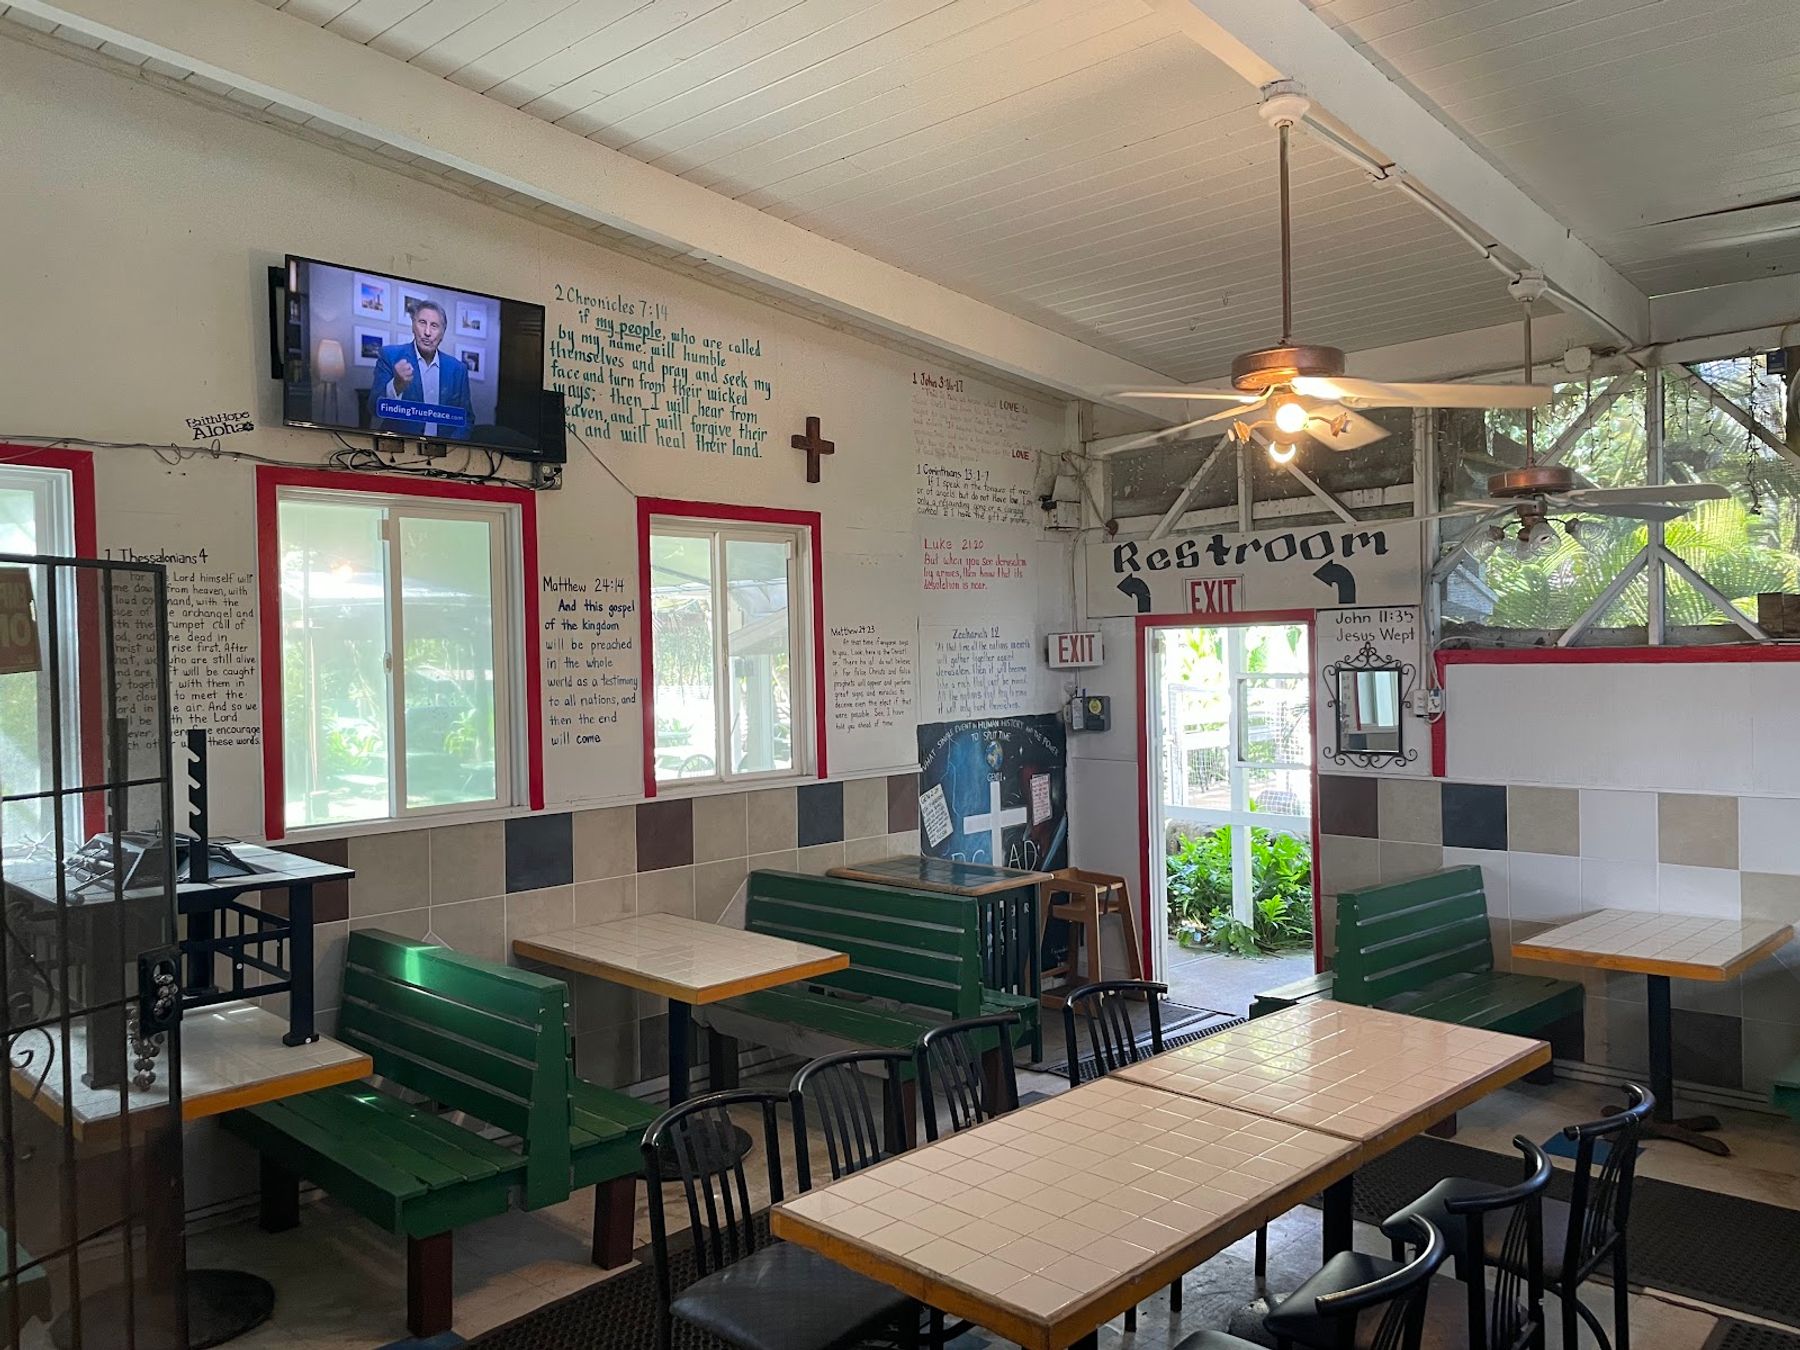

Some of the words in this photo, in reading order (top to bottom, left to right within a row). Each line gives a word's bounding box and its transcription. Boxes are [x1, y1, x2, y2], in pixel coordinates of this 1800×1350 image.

[555, 284, 564, 301] 2
[567, 287, 635, 315] Chronicles
[638, 300, 667, 321] 7:14
[579, 308, 590, 324] if
[595, 317, 614, 338] my
[671, 328, 696, 345] who
[702, 338, 723, 350] are
[729, 338, 761, 357] called
[559, 324, 575, 353] by
[581, 334, 600, 356] my
[651, 343, 675, 359] will
[683, 344, 727, 367] humble
[549, 340, 625, 368] themselves
[632, 356, 655, 373] and
[662, 365, 688, 387] pray
[695, 366, 718, 384] and
[722, 371, 748, 389] seek
[754, 379, 771, 401] my
[550, 359, 580, 379] face
[583, 366, 606, 384] and
[609, 368, 634, 389] turn
[639, 372, 665, 392] from
[673, 378, 703, 398] their
[706, 387, 748, 406] wicked
[380, 403, 464, 421] FindingTruePeace.com
[609, 388, 642, 408] then
[650, 392, 660, 411] I
[666, 397, 690, 415] will
[698, 400, 725, 419] hear
[730, 404, 758, 424] from
[1000, 400, 1019, 413] LOVE
[564, 406, 607, 424] eaven,
[610, 408, 634, 424] and
[641, 408, 651, 427] I
[656, 412, 683, 431] will
[690, 415, 732, 443] forgive
[739, 423, 768, 443] their
[585, 422, 611, 440] and
[620, 426, 647, 444] will
[656, 428, 686, 450] heal
[696, 434, 727, 454] their
[732, 439, 763, 458] land.
[923, 463, 962, 478] Corinthians
[924, 538, 953, 550] Luke
[118, 547, 198, 565] Thessalonians
[199, 547, 208, 564] 4
[924, 552, 938, 565] But
[1113, 530, 1389, 574] Restroom
[173, 570, 195, 582] Lord
[200, 572, 235, 583] himself
[192, 584, 227, 597] heaven,
[228, 586, 248, 596] with
[543, 576, 586, 592] Matthew
[594, 579, 625, 593] 24:14
[196, 597, 218, 606] with
[223, 597, 239, 607] the
[1190, 579, 1237, 614] EXIT
[182, 608, 232, 622] archangel
[236, 608, 254, 618] and
[558, 599, 576, 612] And
[584, 599, 603, 611] this
[608, 600, 635, 618] gospel
[1335, 609, 1371, 625] John
[1378, 609, 1414, 624] 11:35
[168, 618, 205, 633] rumpet
[212, 619, 230, 630] call
[235, 618, 247, 630] of
[544, 617, 556, 630] of
[561, 619, 578, 631] the
[582, 618, 619, 636] kingdom
[187, 630, 213, 642] dead
[217, 633, 228, 641] in
[1336, 627, 1376, 643] Jesus
[1380, 627, 1415, 645] Wept
[172, 644, 192, 653] rise
[224, 642, 248, 653] After
[545, 637, 564, 650] will
[571, 637, 583, 649] be
[591, 637, 633, 655] preached
[1058, 634, 1095, 663] EXIT
[191, 656, 208, 664] are
[212, 652, 232, 664] still
[236, 655, 256, 664] alive
[546, 657, 557, 669] in
[564, 656, 580, 669] the
[586, 656, 614, 668] whole
[183, 666, 200, 676] will
[206, 666, 220, 676] be
[222, 666, 255, 679] caught
[178, 678, 202, 689] with
[207, 678, 230, 687] them
[547, 675, 573, 688] world
[577, 678, 588, 687] as
[591, 679, 599, 687] a
[175, 690, 186, 700] to
[191, 692, 218, 700] meet
[549, 696, 564, 706] to
[564, 694, 576, 706] all
[580, 692, 619, 707] nations,
[621, 692, 636, 704] and
[208, 701, 227, 711] And
[231, 703, 243, 711] so
[189, 714, 208, 724] the
[213, 712, 238, 723] Lord
[549, 714, 572, 725] then
[579, 713, 595, 725] the
[598, 711, 617, 723] end
[216, 726, 261, 737] encourage
[954, 722, 971, 733] EVENT
[977, 719, 1000, 730] HUMAN
[1001, 719, 1024, 729] HISTORY
[207, 736, 233, 747] these
[551, 731, 570, 746] will
[576, 734, 601, 744] come
